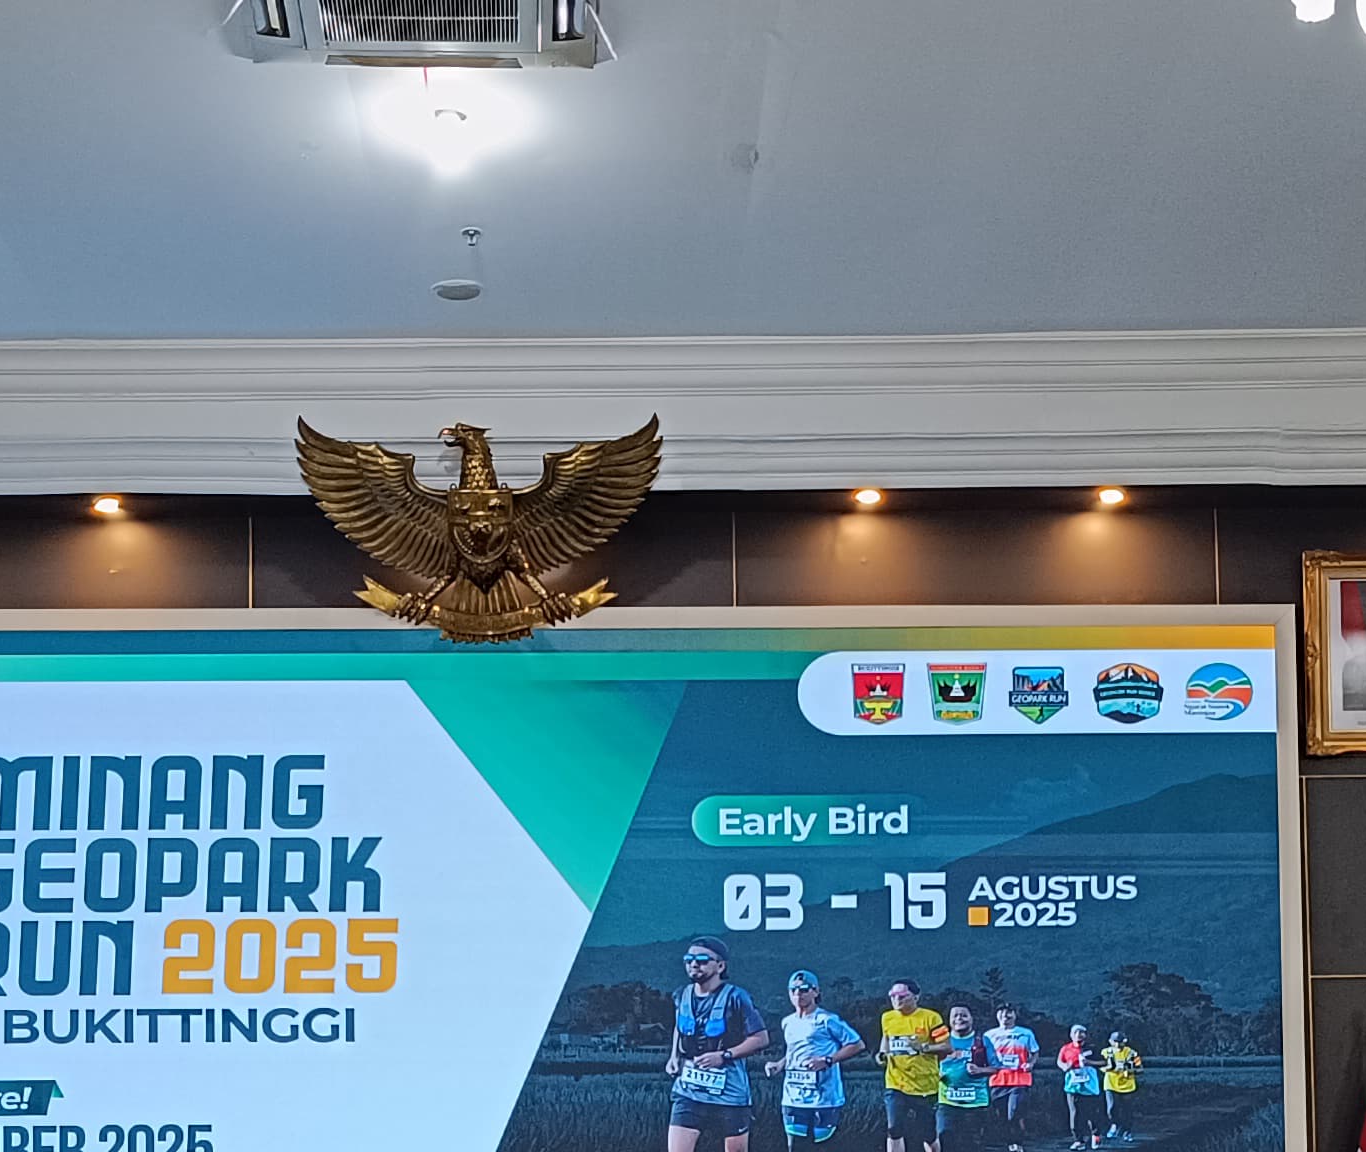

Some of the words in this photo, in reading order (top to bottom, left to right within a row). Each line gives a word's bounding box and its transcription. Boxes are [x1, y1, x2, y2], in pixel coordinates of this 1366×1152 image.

[719, 805, 817, 842] Early
[828, 804, 909, 835] Bird
[723, 873, 804, 931] 03
[884, 871, 947, 930] 15
[968, 875, 1138, 901] AGUSTUS
[993, 902, 1077, 927] 2025
[161, 917, 399, 994] 2025
[3, 1007, 356, 1045] BUKITTINGGI
